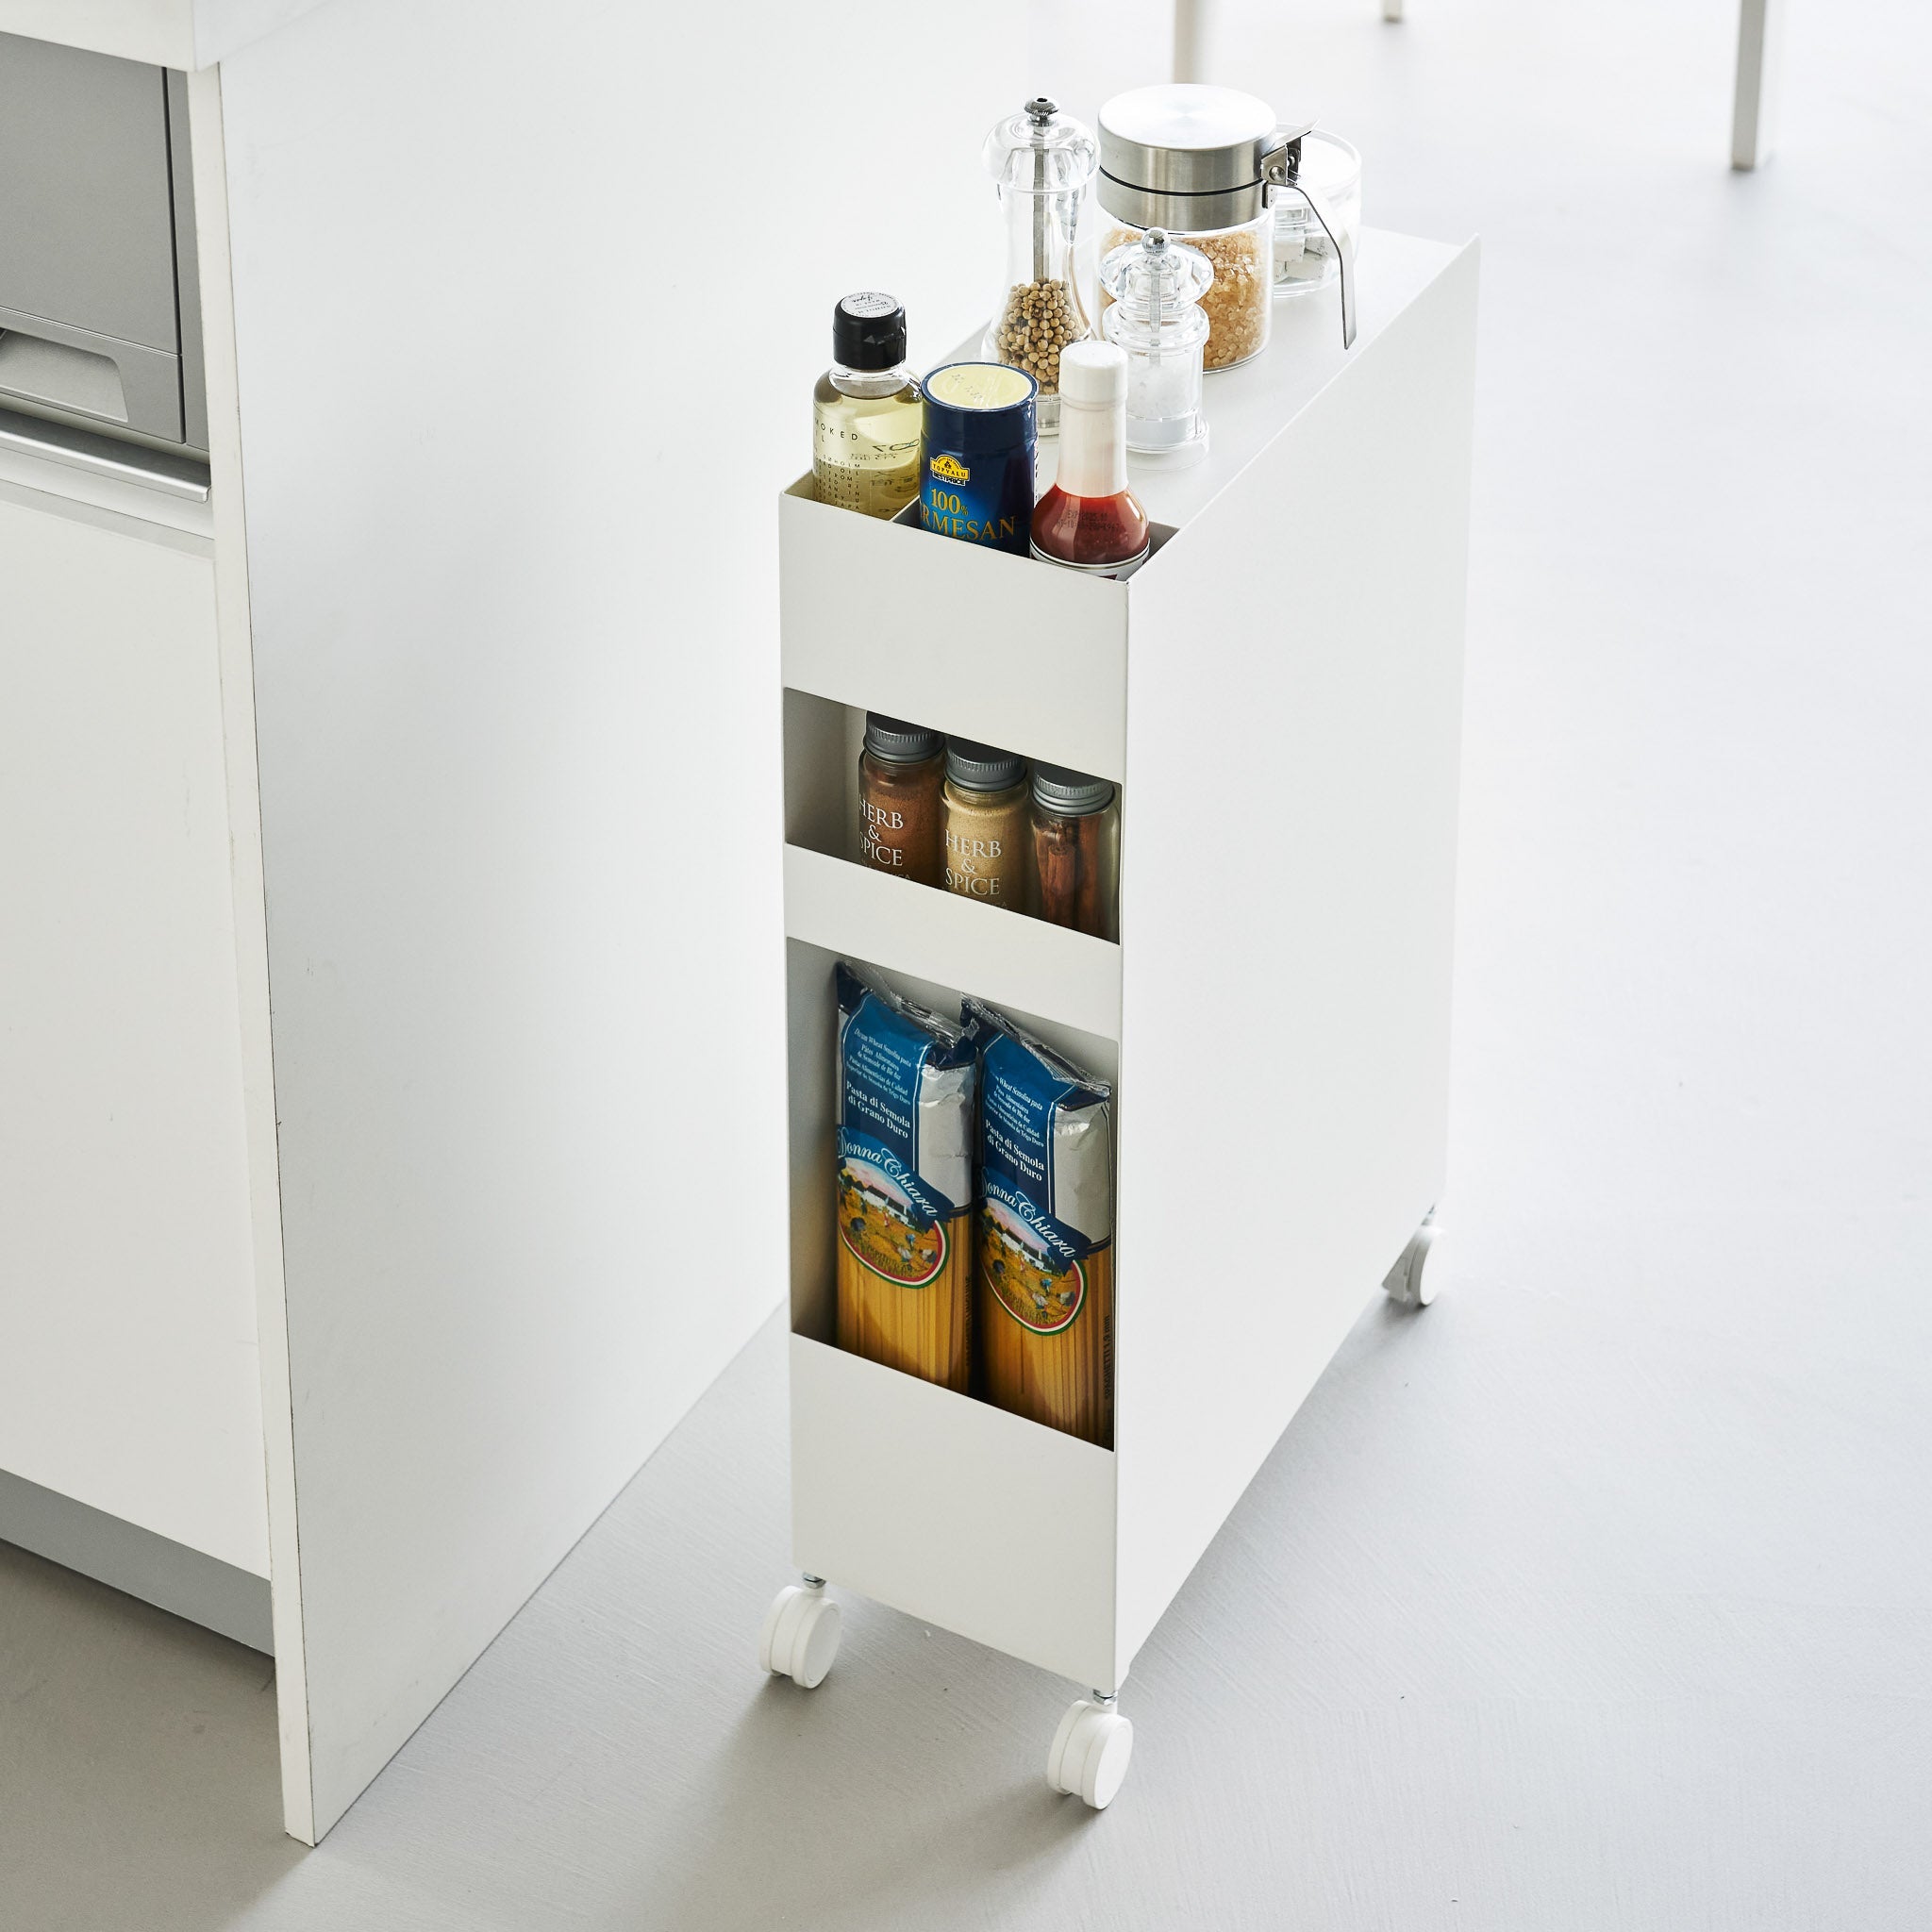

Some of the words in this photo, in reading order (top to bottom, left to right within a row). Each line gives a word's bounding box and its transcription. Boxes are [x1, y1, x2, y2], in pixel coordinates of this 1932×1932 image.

[933, 464, 965, 477] TOPVALU
[921, 503, 1018, 541] RMESAN
[859, 794, 903, 829] HERB
[860, 831, 902, 866] SPICE
[869, 824, 882, 842] &
[945, 829, 1001, 859] HERB
[946, 868, 1000, 896] SPICE
[962, 858, 978, 874] &
[846, 1080, 867, 1102] Pasta
[869, 1096, 878, 1108] di
[880, 1101, 910, 1128] Semola
[848, 1094, 856, 1105] di
[857, 1100, 885, 1123] Grano
[887, 1117, 908, 1139] Duro
[985, 1119, 1004, 1142] Pasta
[1004, 1136, 1012, 1150] di
[1014, 1144, 1044, 1172] Semola
[987, 1135, 994, 1146] di
[995, 1140, 1018, 1167] Grano
[1020, 1161, 1042, 1183] Duro
[836, 1127, 883, 1164] Donna
[881, 1147, 939, 1217] Chiara
[1016, 1190, 1076, 1258] Chiara
